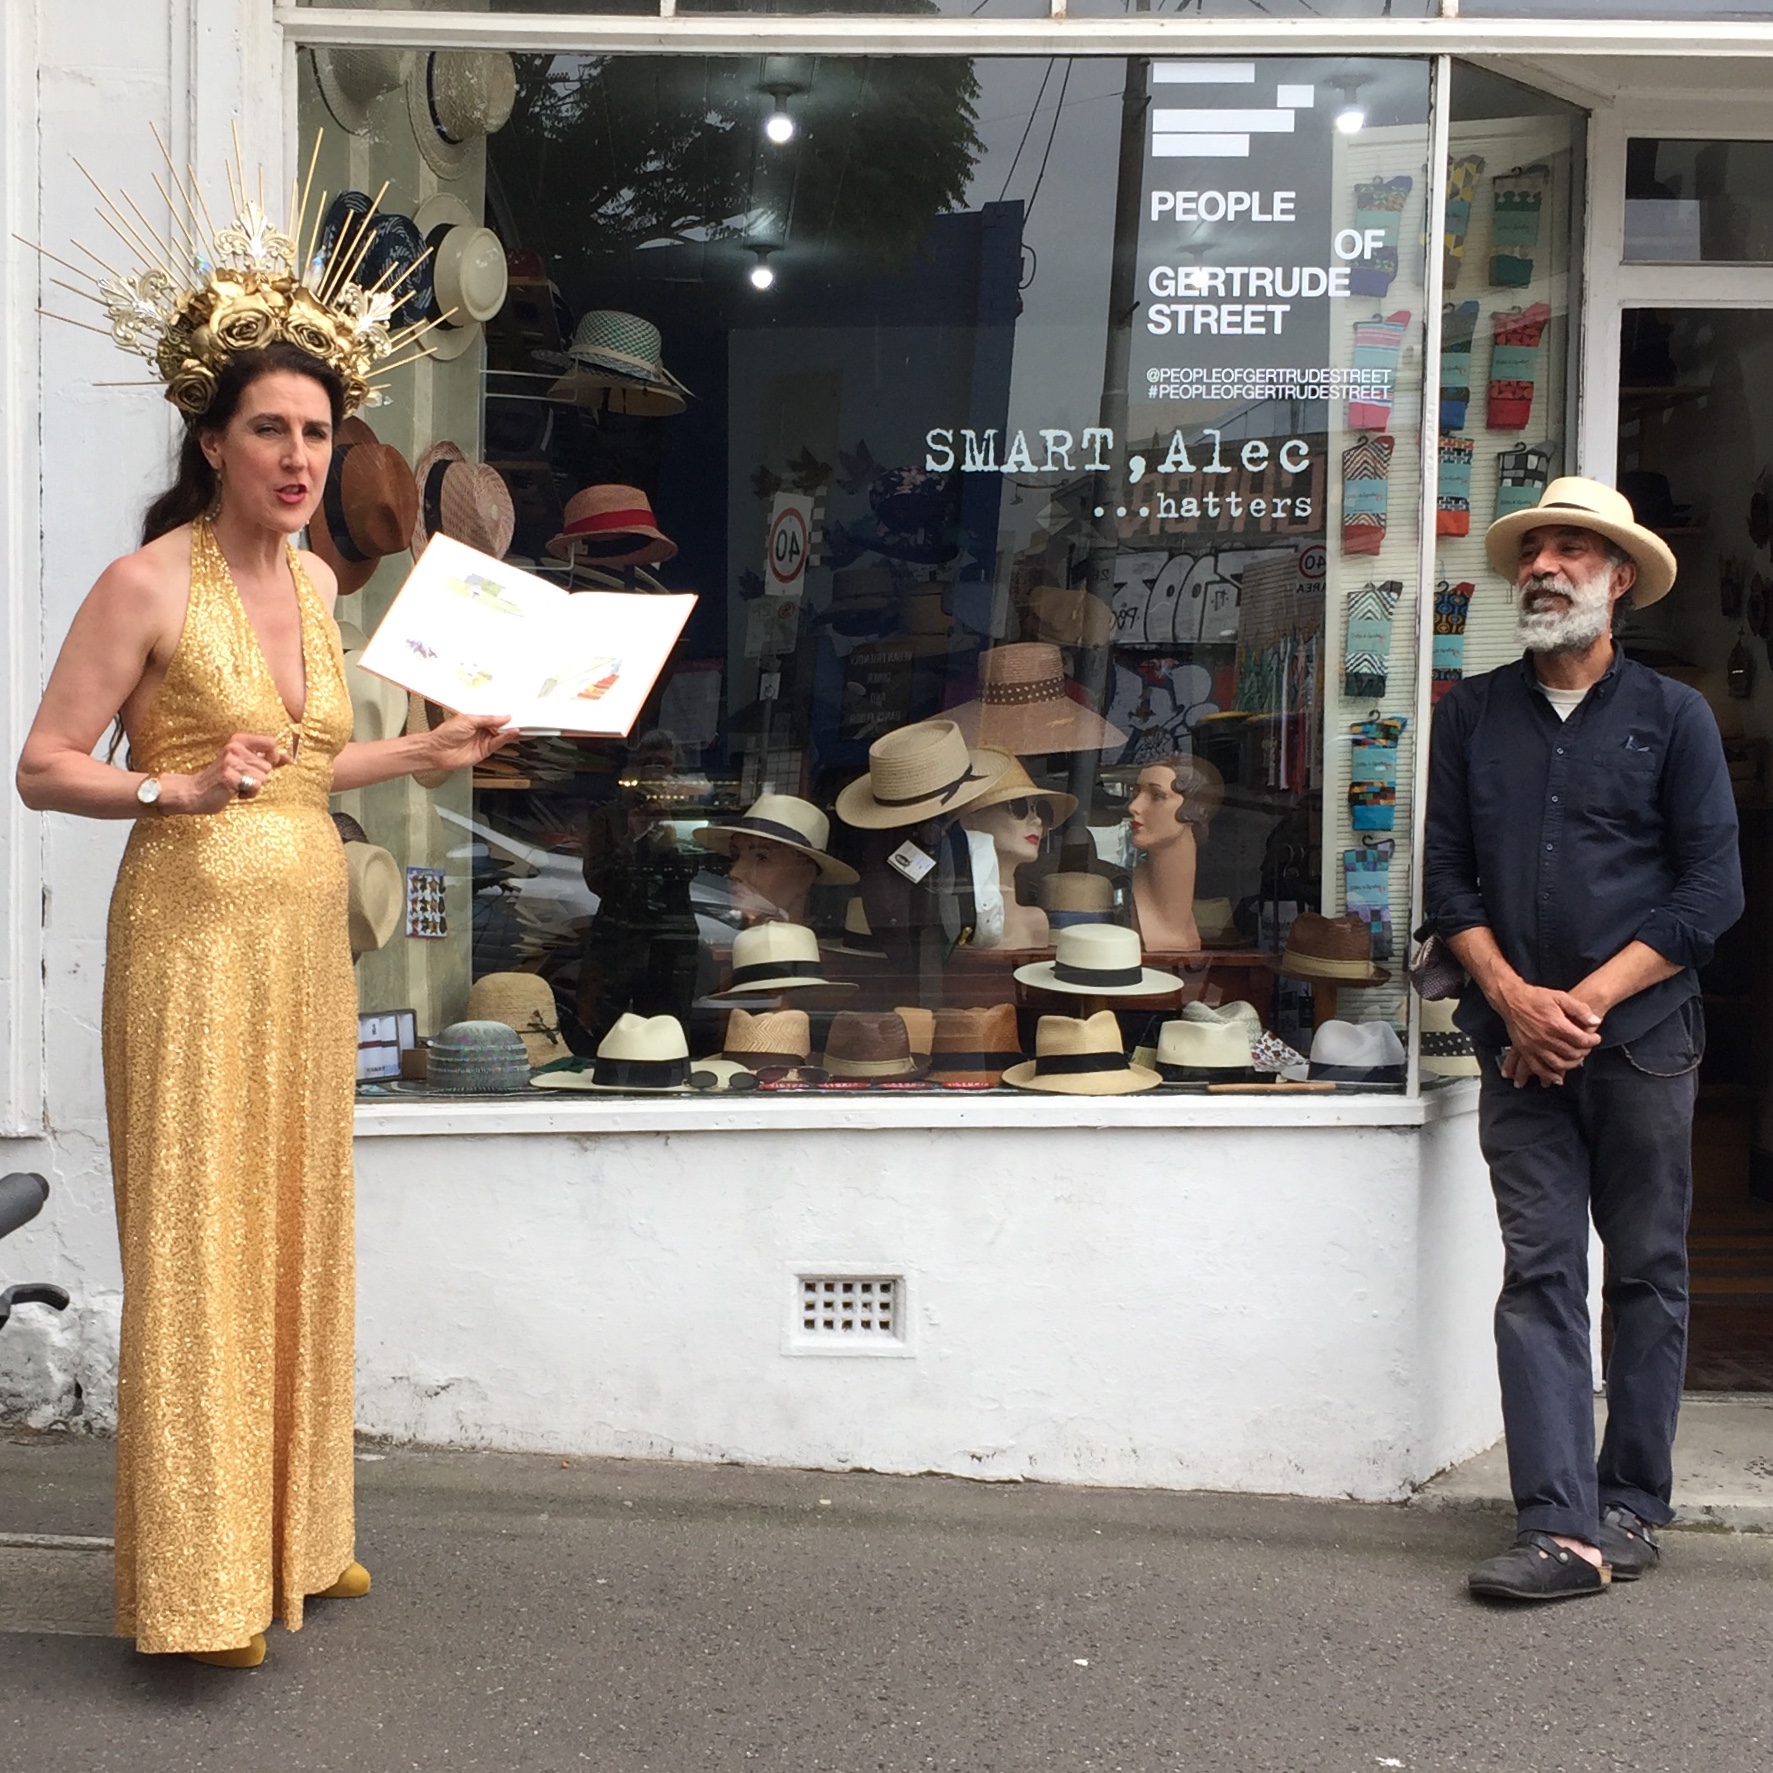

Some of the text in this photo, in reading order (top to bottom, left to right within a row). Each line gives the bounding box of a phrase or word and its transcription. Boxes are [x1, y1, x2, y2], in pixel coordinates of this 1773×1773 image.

[1150, 191, 1296, 222] PEOPLE
[1334, 229, 1386, 260] OF
[1148, 266, 1351, 297] GERTRUDE
[1147, 304, 1291, 335] STREET
[1146, 368, 1391, 384] @PEOPLEOFGERTRUDESTREET
[1148, 384, 1391, 400] #PEOPLEOFGERTRUDESTREET
